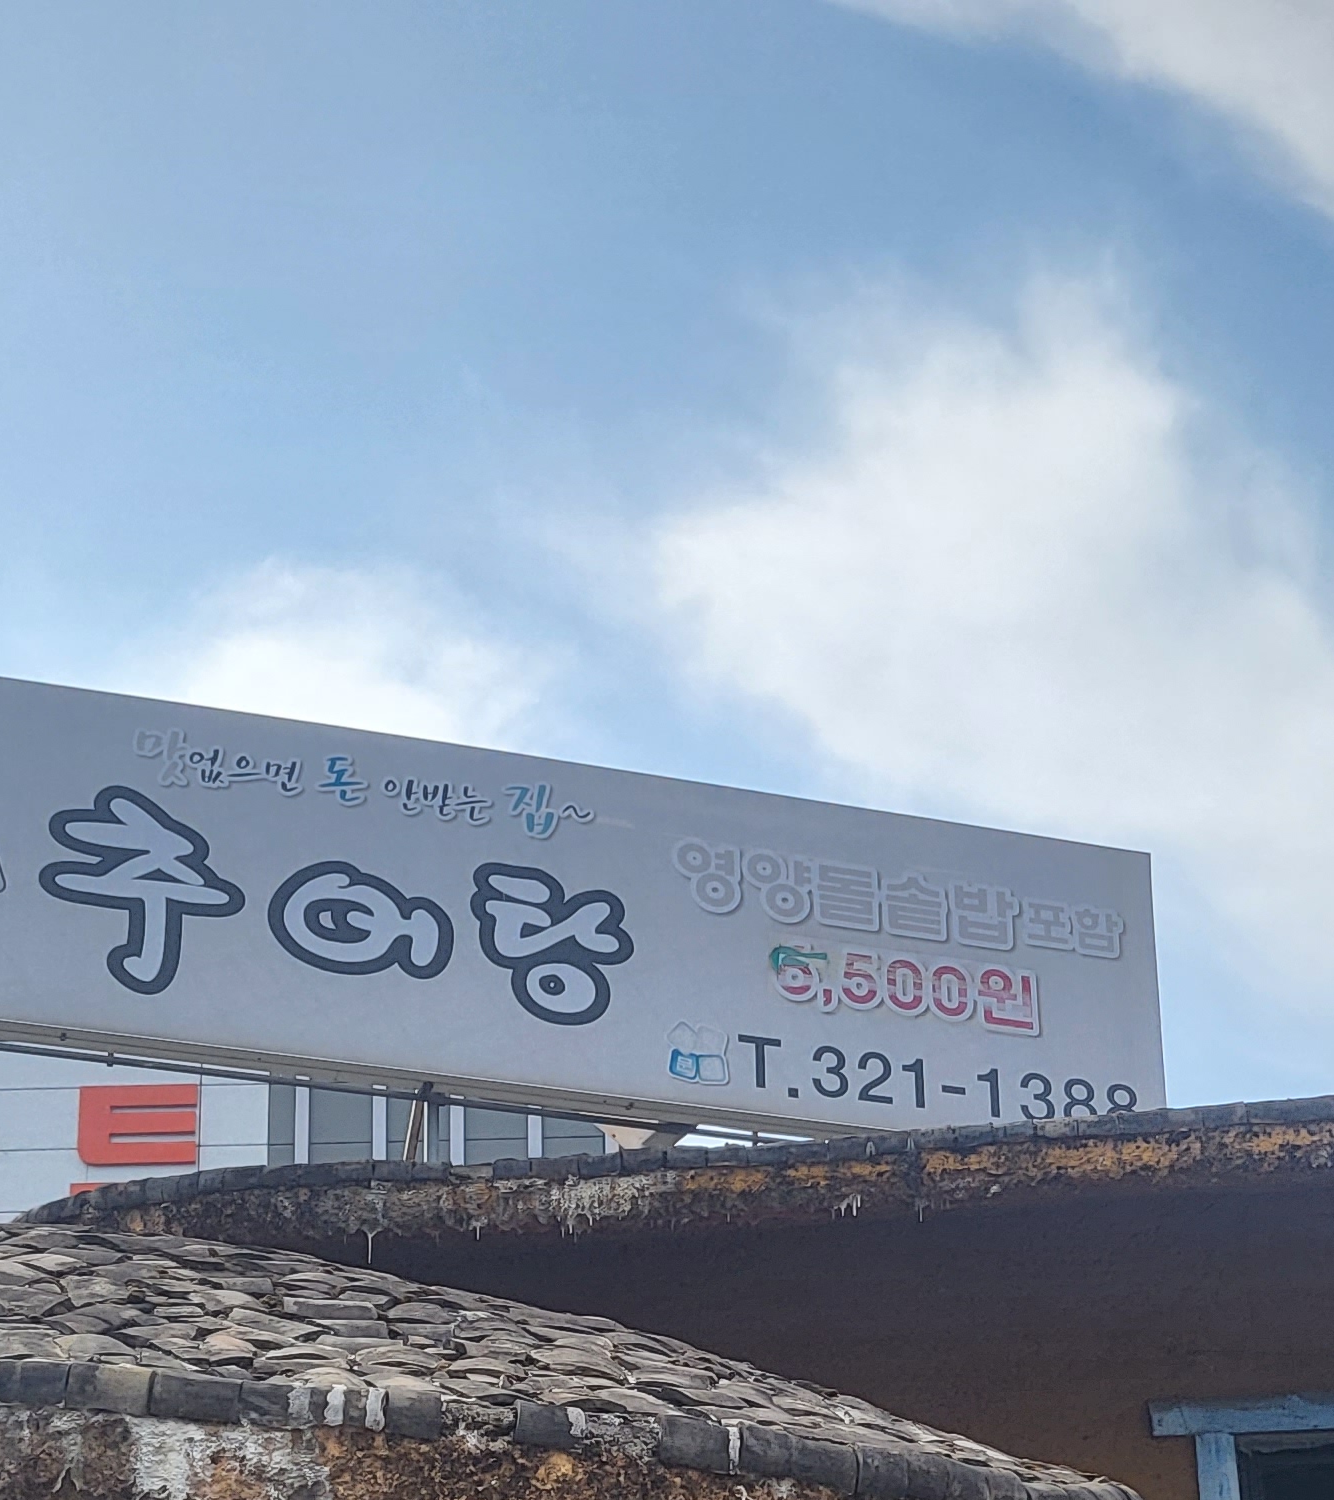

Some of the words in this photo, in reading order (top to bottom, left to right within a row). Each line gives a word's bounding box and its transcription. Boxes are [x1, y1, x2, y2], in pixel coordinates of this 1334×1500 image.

[134, 729, 301, 788] 맛없으면
[317, 755, 366, 802] 돈
[384, 777, 493, 824] 안받는
[38, 785, 635, 1026] 추어탕
